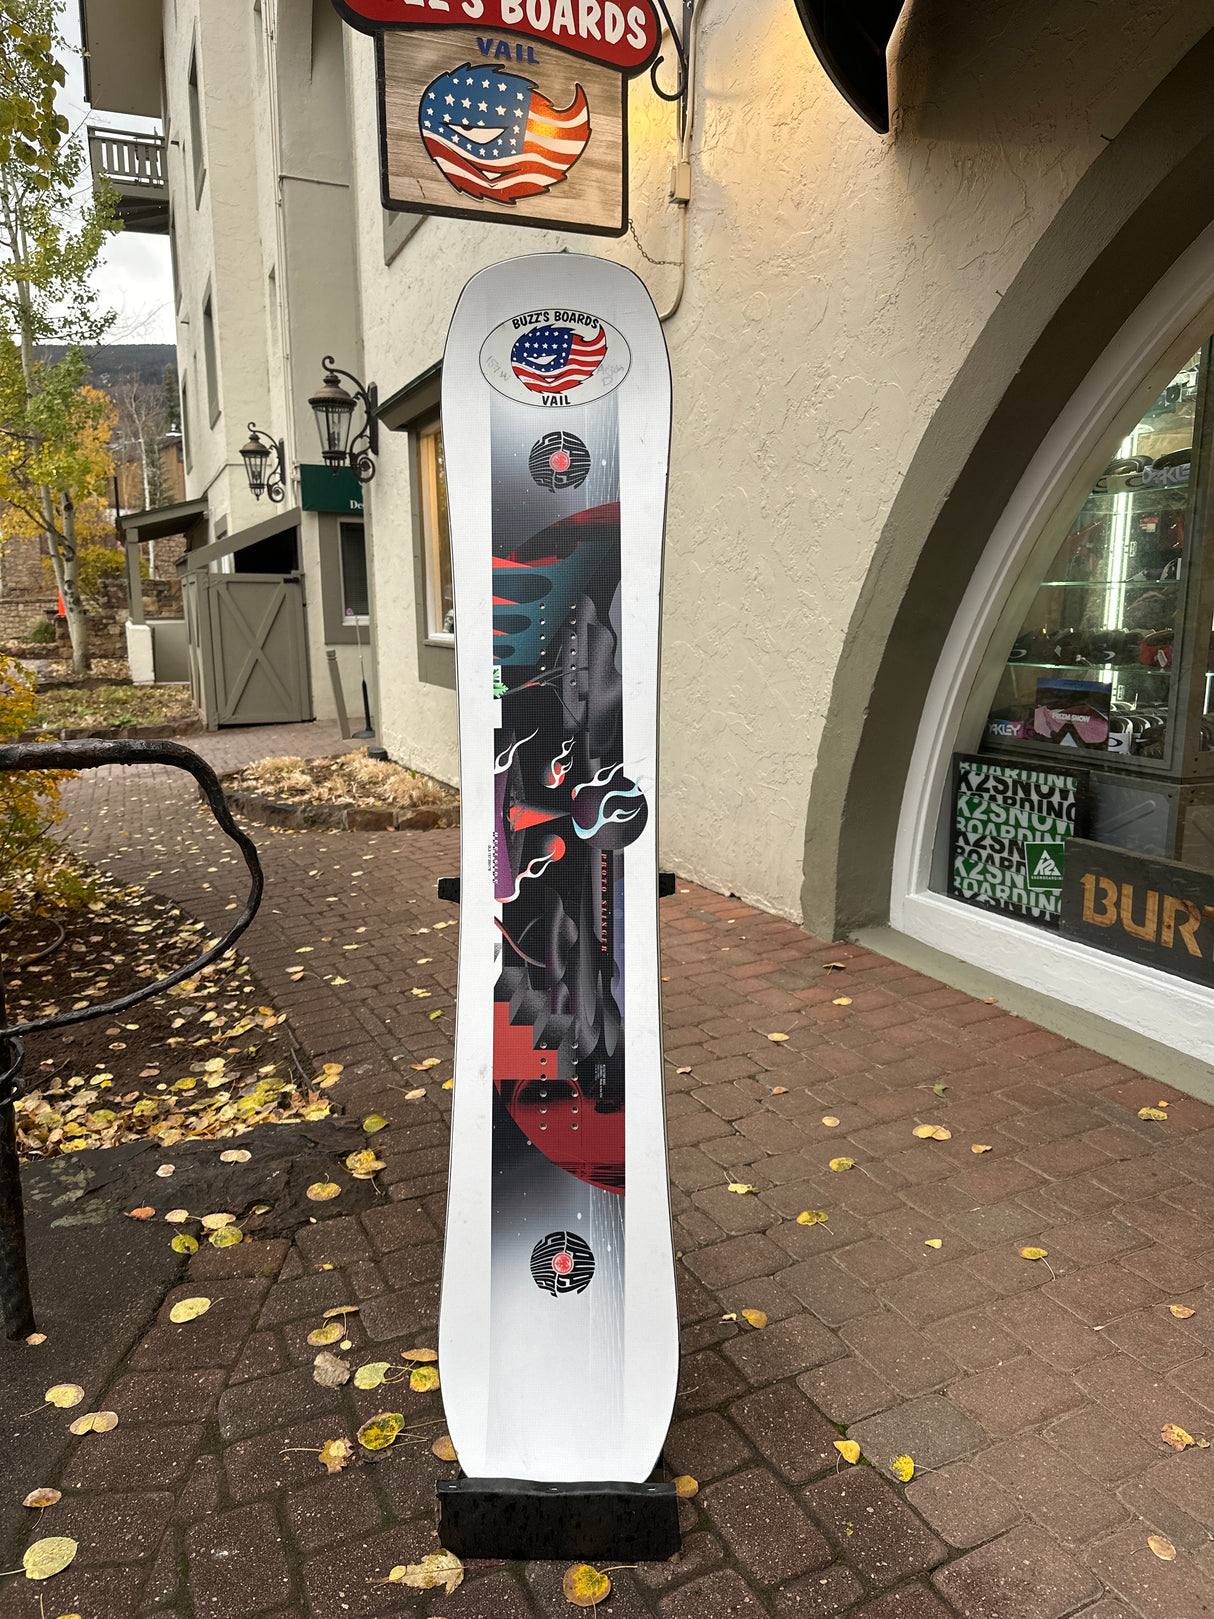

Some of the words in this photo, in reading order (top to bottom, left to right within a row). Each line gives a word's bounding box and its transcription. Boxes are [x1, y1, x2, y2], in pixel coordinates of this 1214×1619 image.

[501, 0, 647, 49] BOARDS
[477, 37, 540, 64] VAIL
[512, 311, 550, 329] BUZZ'S
[554, 311, 599, 329] BOARDS
[542, 395, 571, 406] VAIL
[987, 722, 1021, 737] AKLEY
[1080, 873, 1214, 961] BUR
